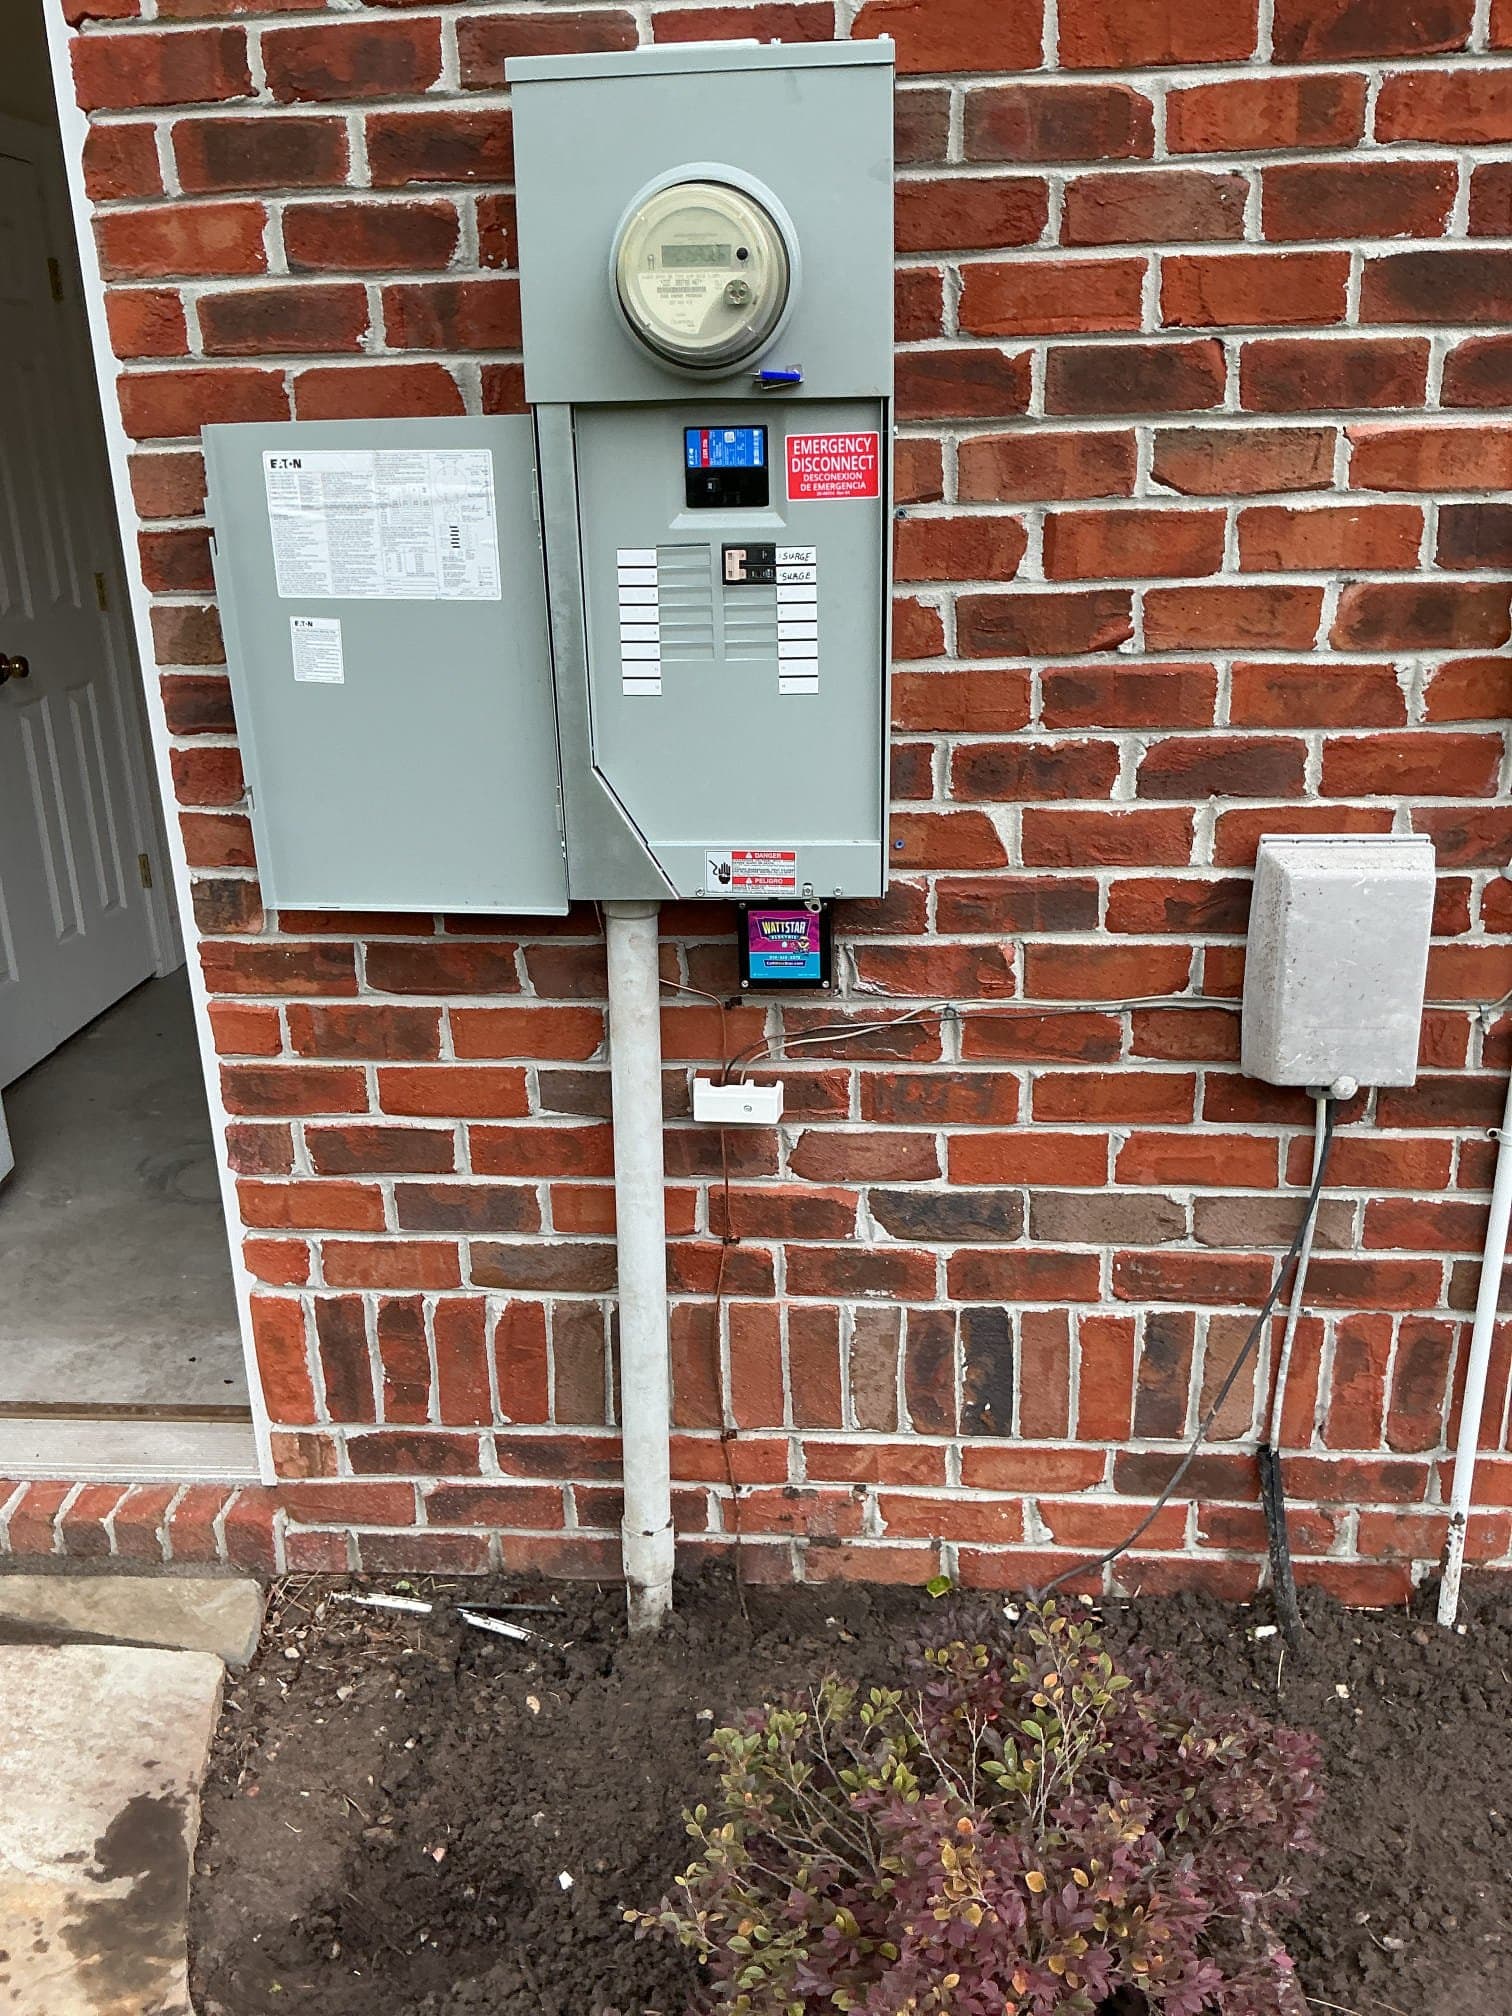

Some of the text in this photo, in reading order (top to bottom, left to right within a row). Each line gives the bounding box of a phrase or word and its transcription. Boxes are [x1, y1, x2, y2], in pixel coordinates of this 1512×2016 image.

[793, 437, 872, 455] EMERGENCY
[791, 455, 875, 473] DISCONNECT
[803, 472, 863, 482] DESCONEXION
[800, 481, 867, 492] DE EMERGENCIA
[761, 921, 806, 934] WATTSTAR
